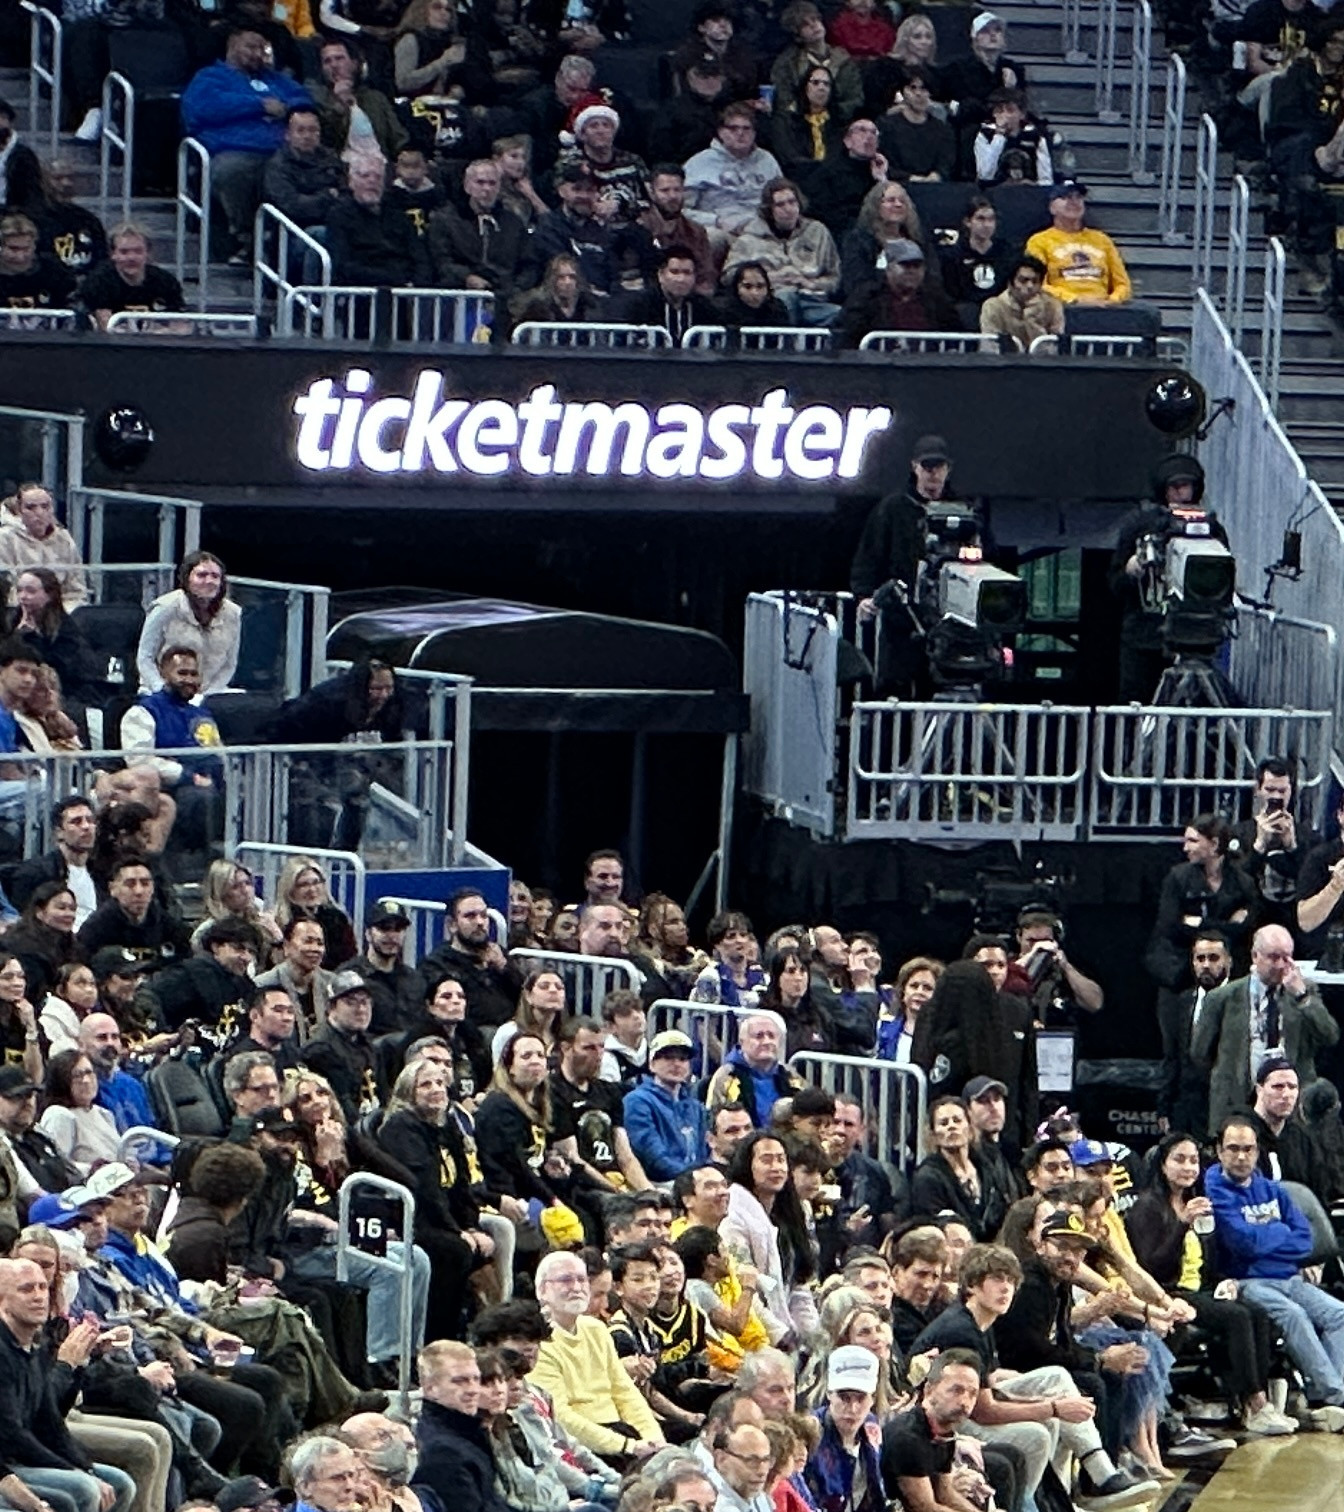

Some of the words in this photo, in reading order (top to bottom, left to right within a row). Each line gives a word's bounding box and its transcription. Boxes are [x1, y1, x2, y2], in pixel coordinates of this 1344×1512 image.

[293, 367, 893, 480] ticketmaster
[1107, 1109, 1159, 1122] CHASE
[1116, 1123, 1162, 1135] CENTE
[593, 1140, 615, 1161] 22
[355, 1217, 382, 1239] 16
